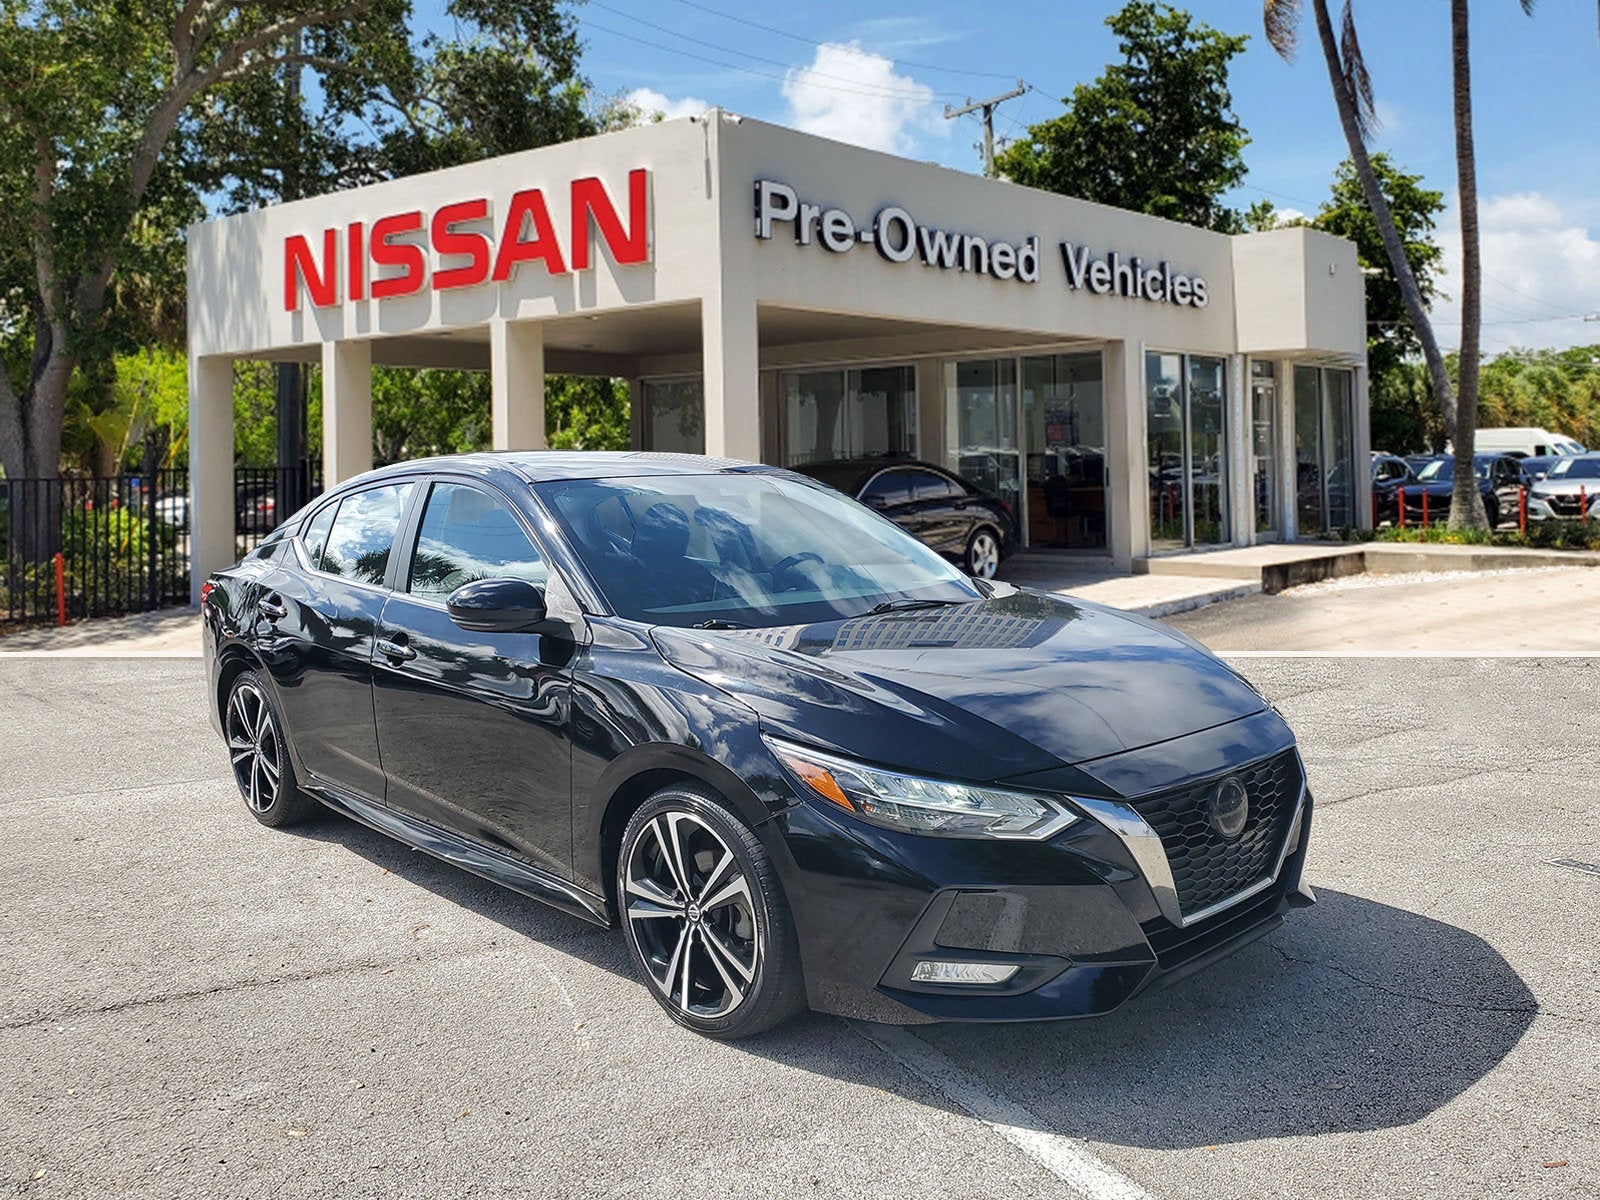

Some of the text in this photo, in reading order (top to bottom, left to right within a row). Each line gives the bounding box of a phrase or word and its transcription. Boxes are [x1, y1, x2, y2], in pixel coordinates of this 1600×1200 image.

[284, 168, 648, 313] NISSAN
[755, 179, 1209, 309] Pre-Owned Vehicles
